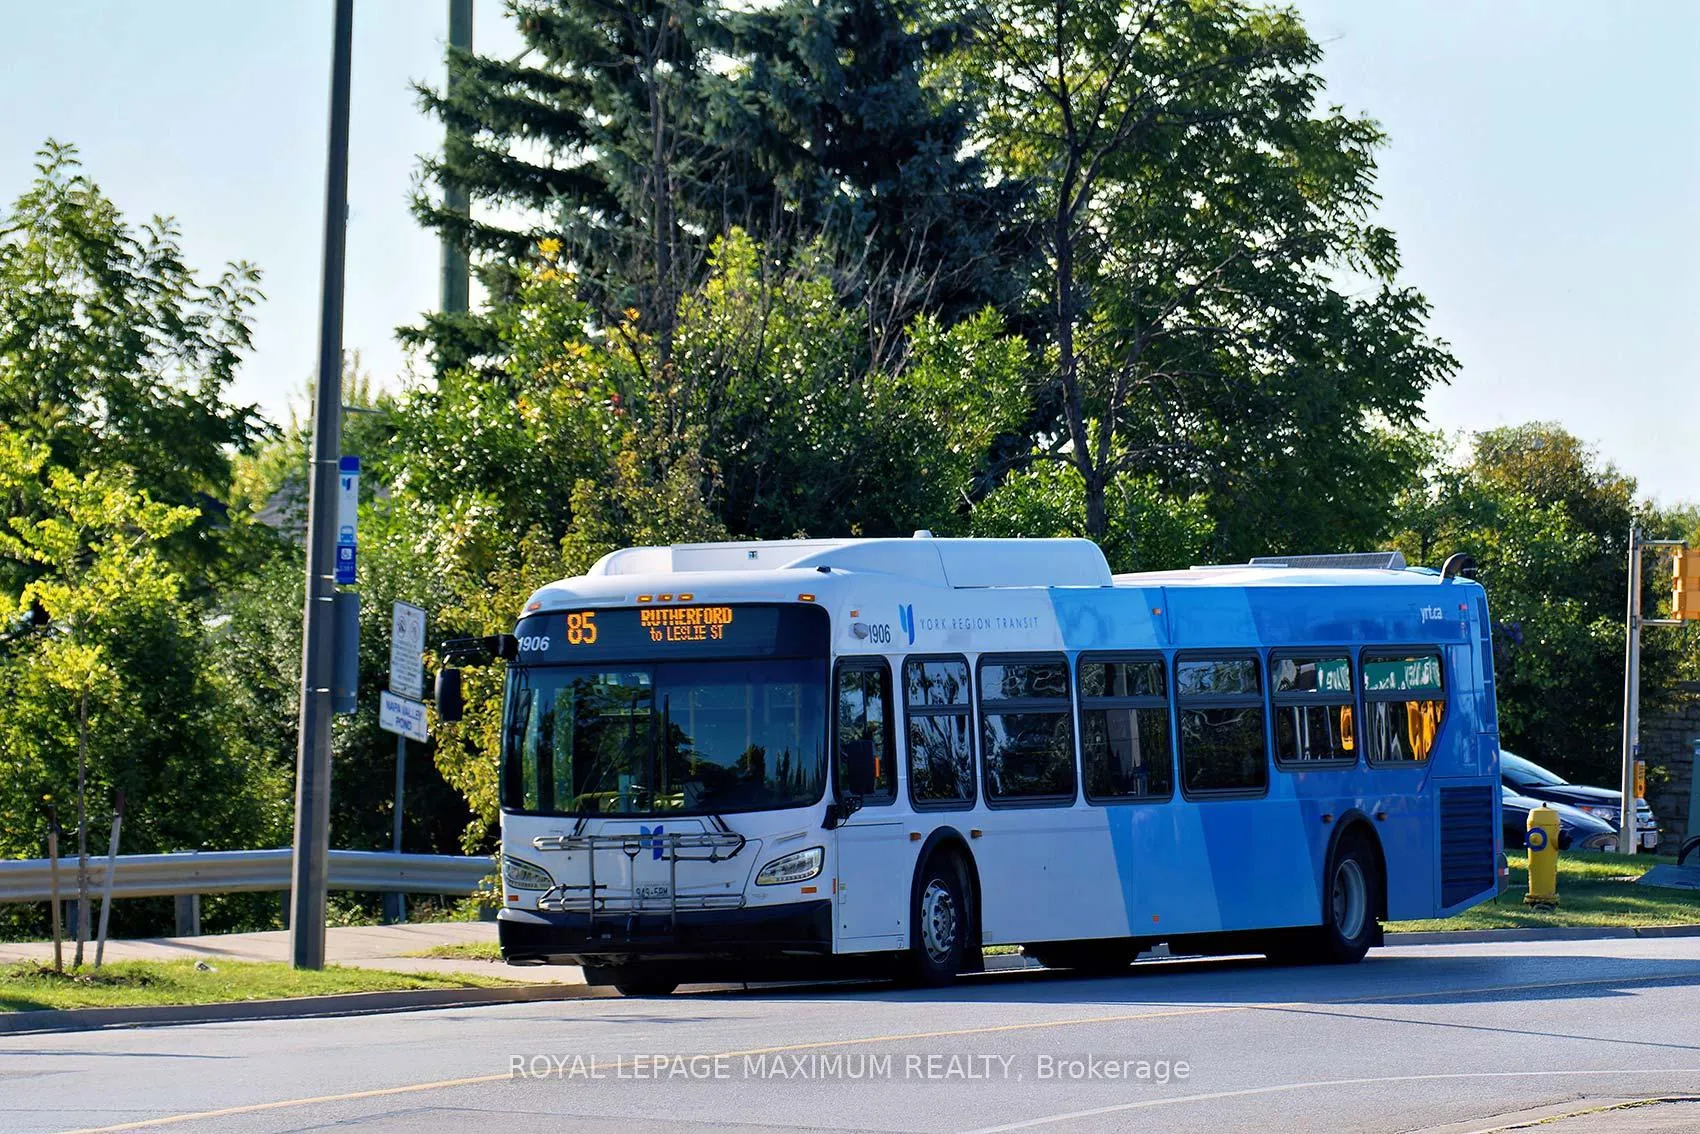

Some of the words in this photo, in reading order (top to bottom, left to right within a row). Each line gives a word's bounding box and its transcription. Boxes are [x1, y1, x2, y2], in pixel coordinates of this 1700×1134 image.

[641, 607, 733, 627] RUTHERFORD
[920, 618, 946, 631] YORK
[952, 616, 991, 630] REGION
[996, 616, 1039, 629] TRANSIT
[1420, 604, 1443, 624] yrt.ca
[567, 611, 597, 644] 85
[650, 627, 663, 642] to
[667, 625, 707, 641] LESLIE
[711, 624, 724, 640] ST
[868, 624, 891, 644] 1906
[518, 636, 550, 651] 1906
